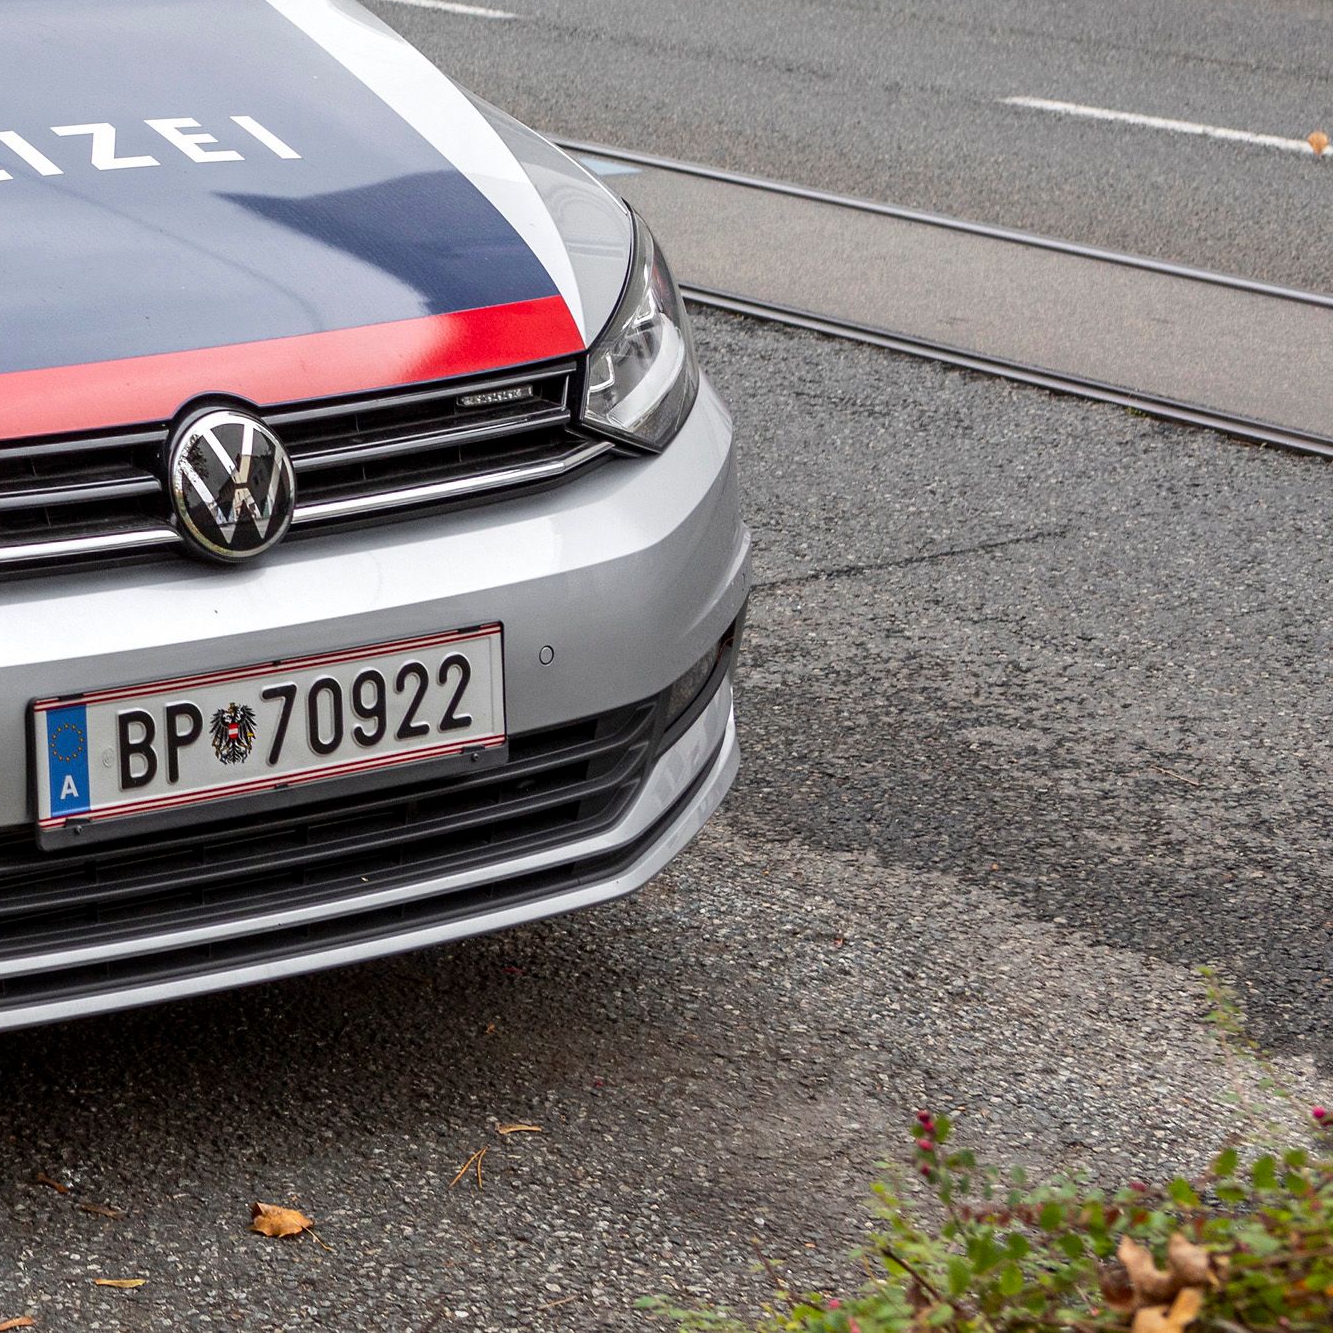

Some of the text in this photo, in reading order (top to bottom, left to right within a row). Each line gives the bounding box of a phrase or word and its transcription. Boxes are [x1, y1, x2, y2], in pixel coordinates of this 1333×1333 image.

[117, 651, 473, 791] BP 70922
[59, 774, 80, 800] A
